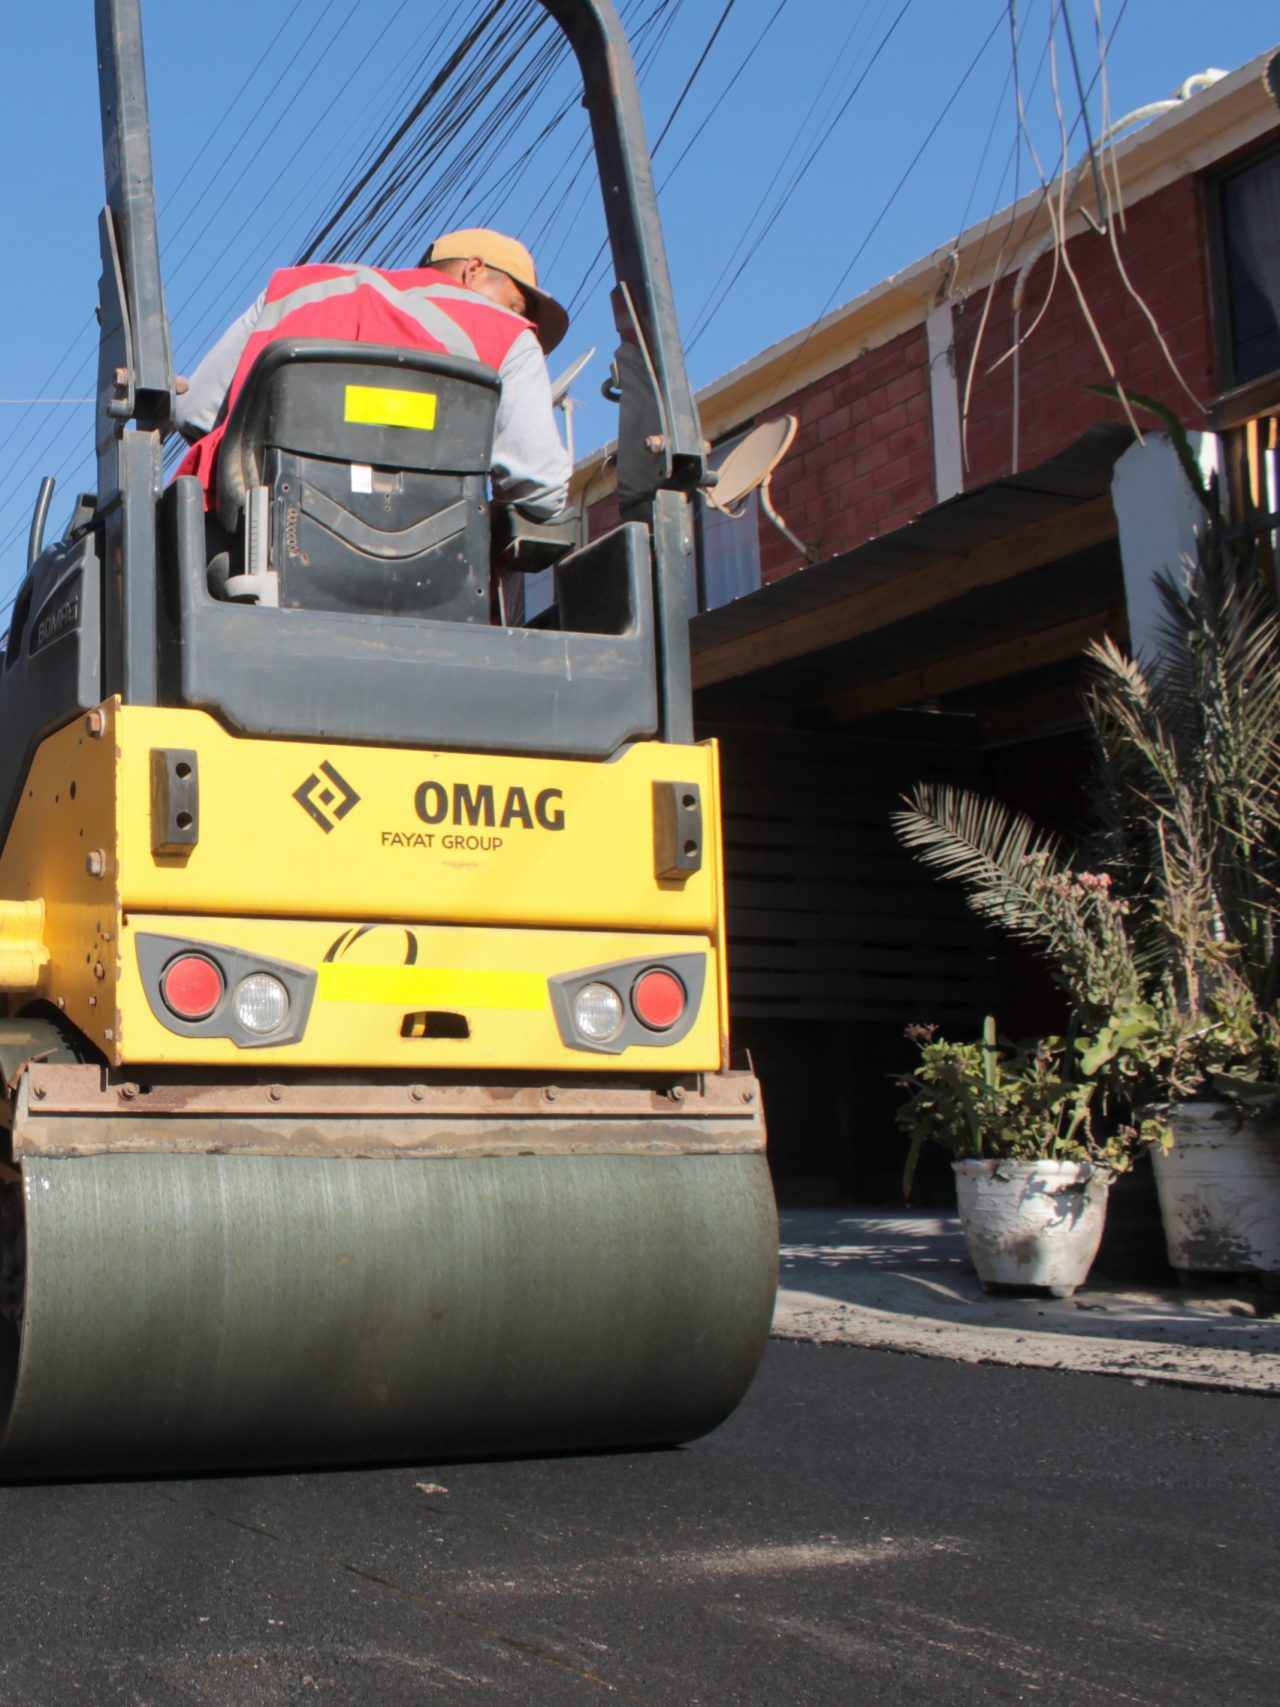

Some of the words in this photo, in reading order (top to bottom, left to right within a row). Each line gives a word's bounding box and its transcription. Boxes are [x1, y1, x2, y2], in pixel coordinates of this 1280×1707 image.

[414, 780, 565, 831] OMAG
[381, 831, 435, 848] FAYAT
[441, 834, 503, 851] GROUP
